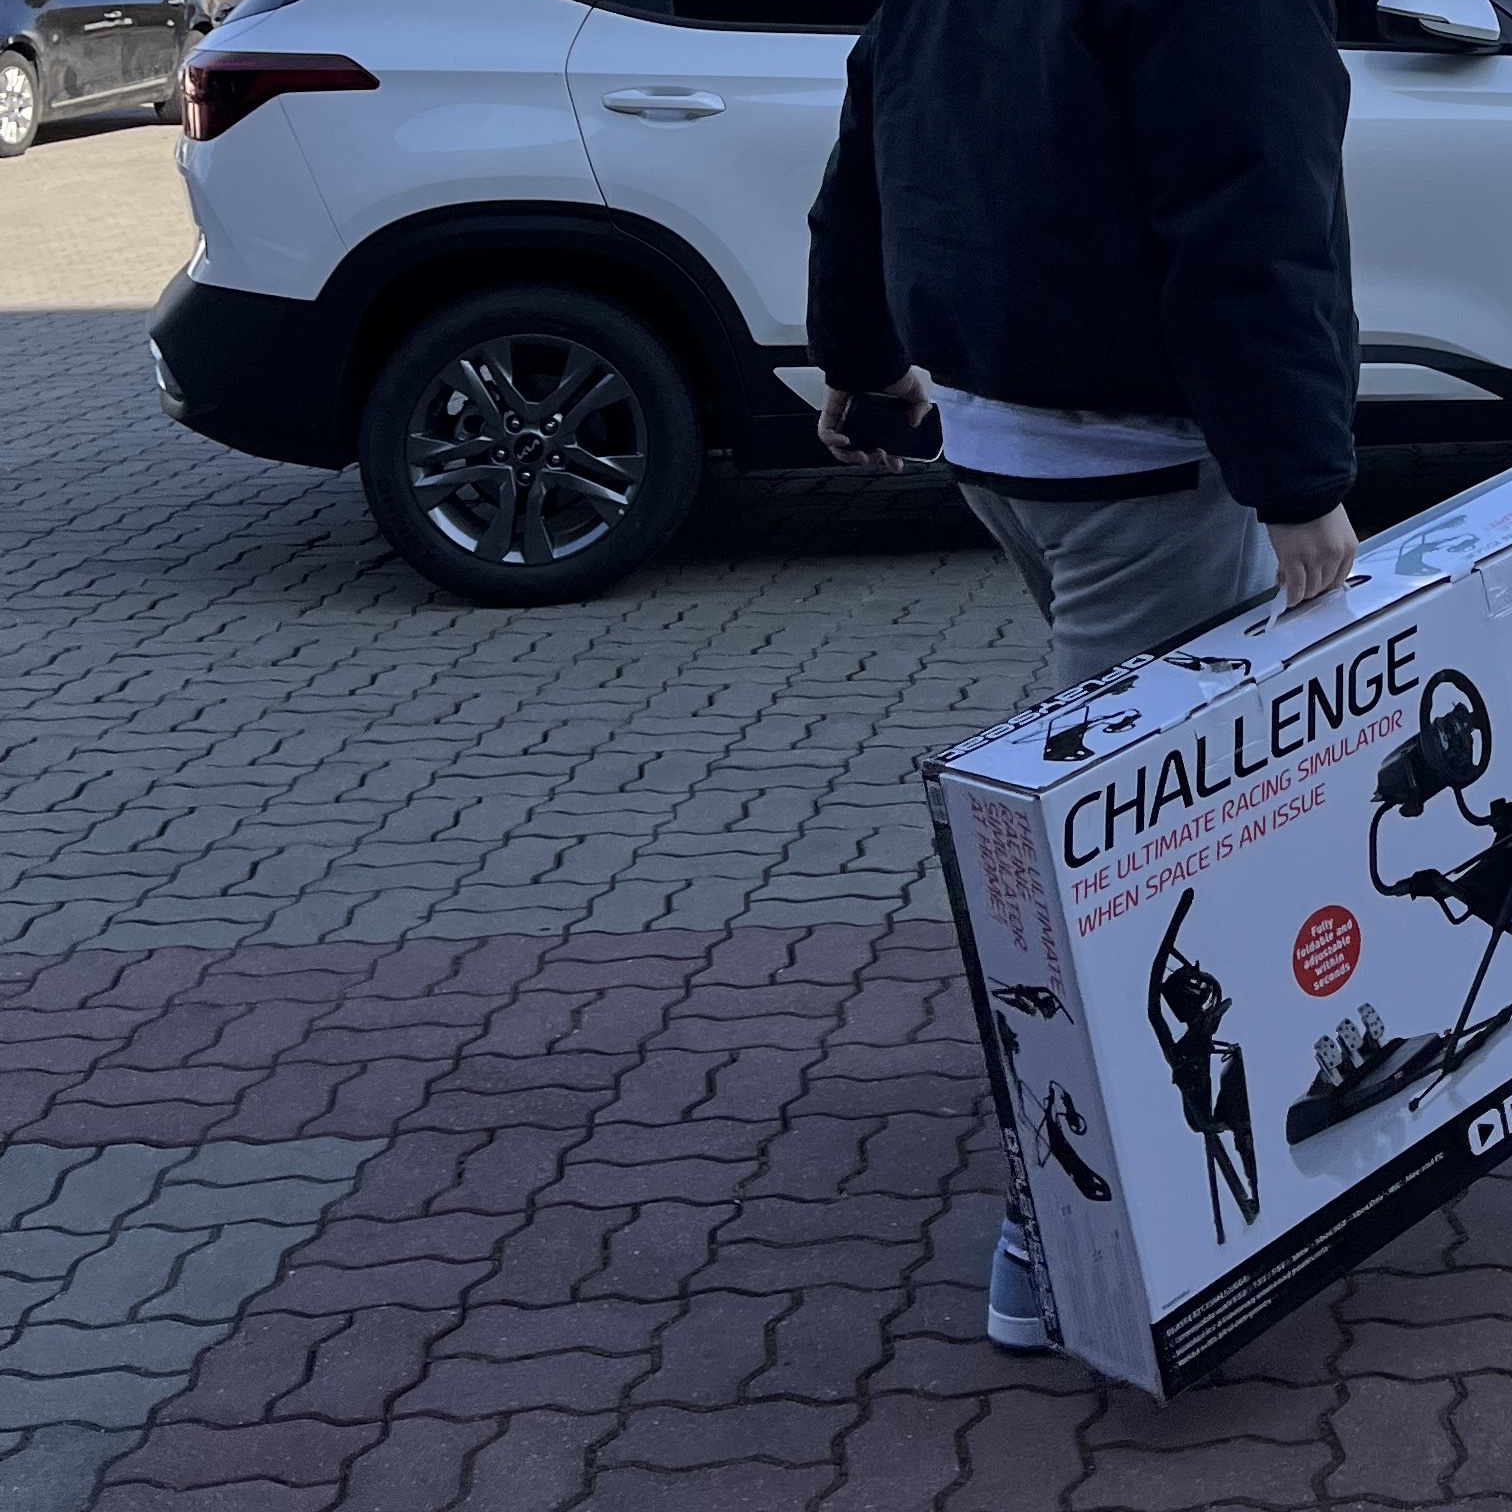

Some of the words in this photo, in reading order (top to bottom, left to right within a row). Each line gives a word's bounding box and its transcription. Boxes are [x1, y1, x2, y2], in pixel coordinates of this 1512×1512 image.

[1063, 625, 1419, 868] CHALLENGE
[1071, 865, 1110, 905] THE
[1117, 808, 1215, 880] ULTIMATE
[1222, 768, 1292, 820] RACING
[1298, 709, 1403, 783] SIMULATOR
[1014, 810, 1038, 863] THE
[1026, 865, 1067, 998] ULTIMATE
[1078, 886, 1139, 937] WHEN
[1146, 845, 1211, 900] SPACE
[1216, 833, 1233, 862] IS
[1239, 815, 1266, 845] AN
[1272, 783, 1326, 830] ISSUE
[1296, 932, 1334, 960] foldable
[1336, 918, 1353, 936] and
[1303, 935, 1351, 970] adjustable
[1313, 963, 1351, 991] seconds
[1314, 953, 1345, 976] within
